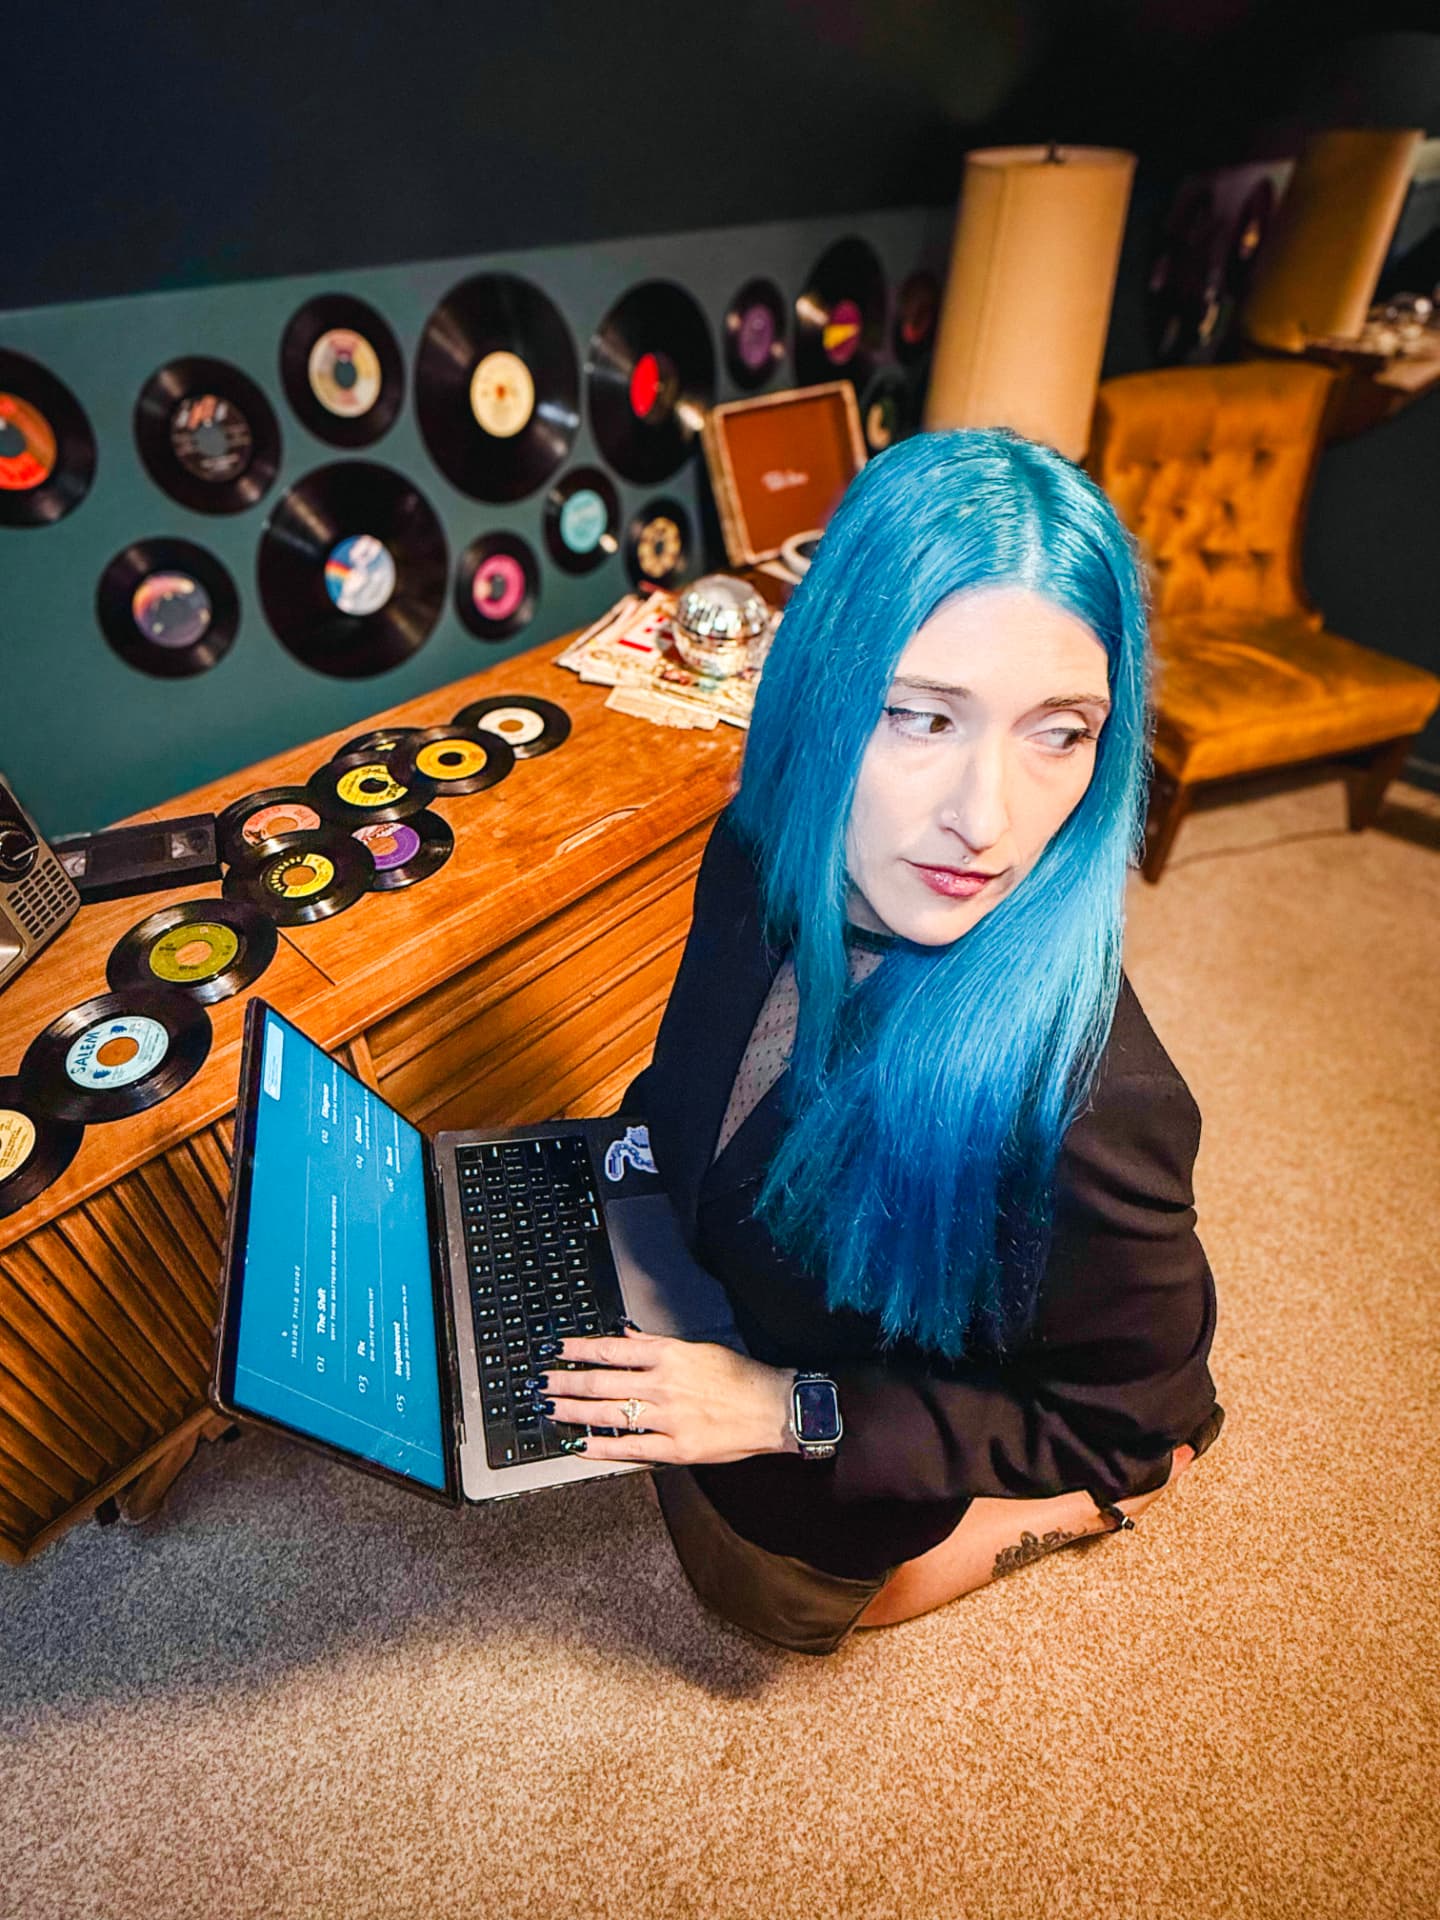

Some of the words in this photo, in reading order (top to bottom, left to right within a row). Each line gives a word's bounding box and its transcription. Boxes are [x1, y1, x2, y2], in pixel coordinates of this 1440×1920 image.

[70, 1031, 102, 1076] SALEM
[293, 1264, 301, 1294] GUIDE
[292, 1297, 300, 1319] THIS
[317, 1287, 326, 1312] Shift
[317, 1313, 326, 1335] The
[291, 1323, 299, 1359] INSIDE
[357, 1340, 366, 1357] Fix
[393, 1320, 403, 1376] Implement
[316, 1355, 325, 1373] 01
[358, 1375, 369, 1393] 03
[396, 1393, 406, 1412] 05
